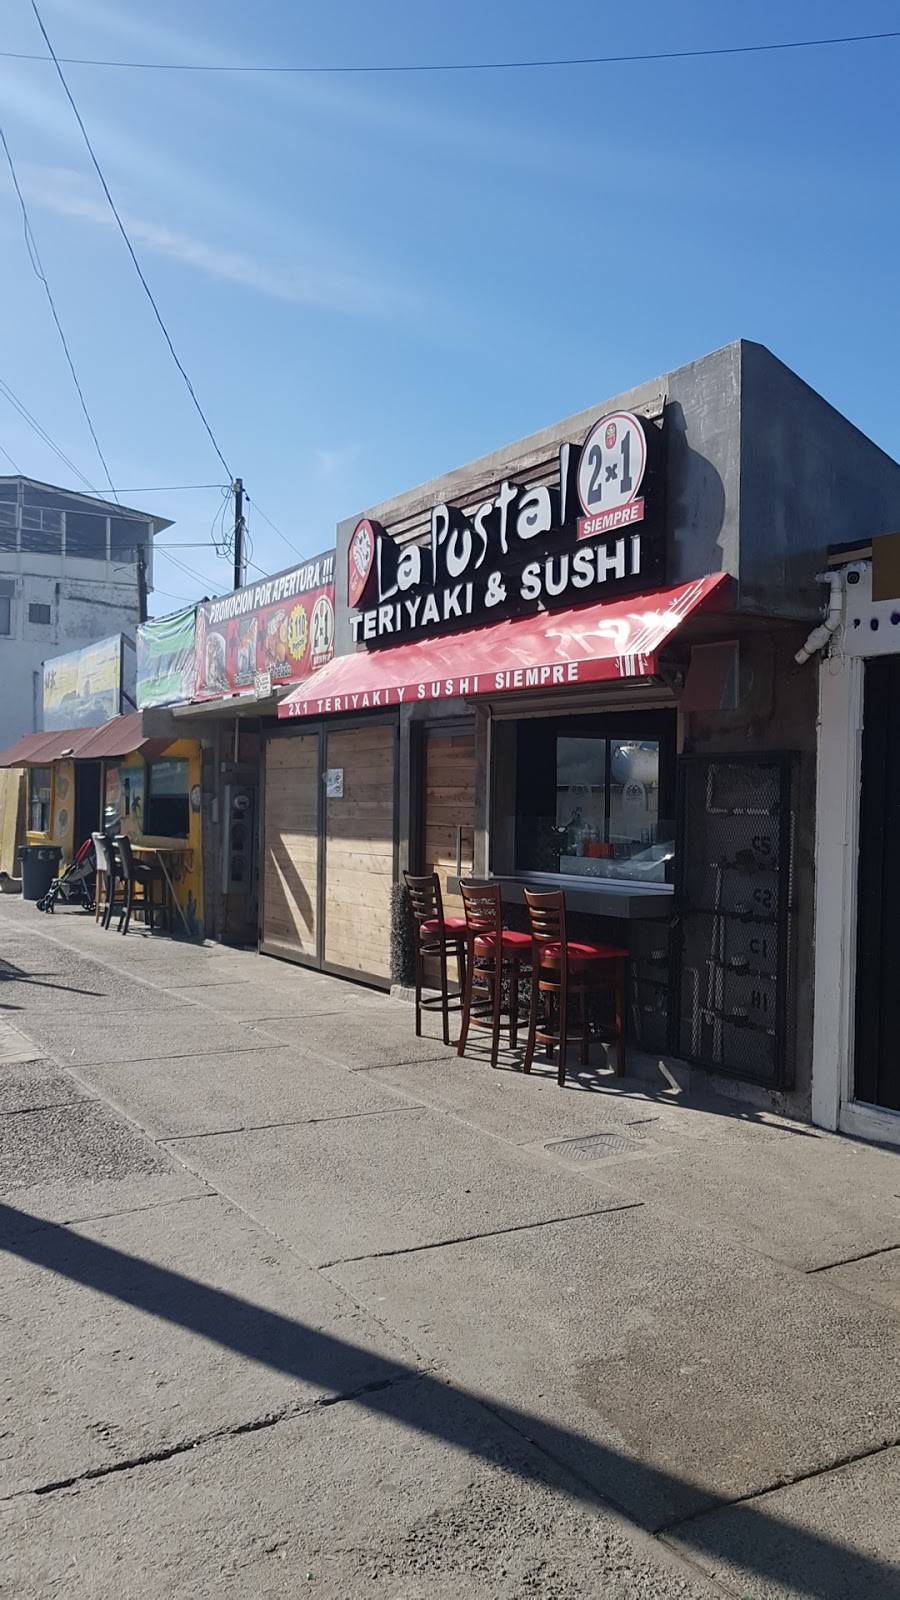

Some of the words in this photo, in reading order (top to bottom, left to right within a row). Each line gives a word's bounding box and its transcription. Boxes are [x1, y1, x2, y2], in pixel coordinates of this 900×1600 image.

[586, 429, 633, 506] 2x1
[583, 507, 639, 535] SIEMPRE
[209, 588, 255, 625] PROMOCION
[254, 582, 273, 609] POR
[272, 562, 320, 601] APERTURA
[349, 581, 473, 642] TERIYAKI
[485, 571, 507, 608] &
[521, 534, 642, 602] SUSHI
[376, 534, 421, 604] La
[316, 689, 390, 714] TERIYAKI
[396, 685, 406, 702] Y
[417, 676, 480, 700] SUSHI
[495, 662, 580, 690] SIEMPRE
